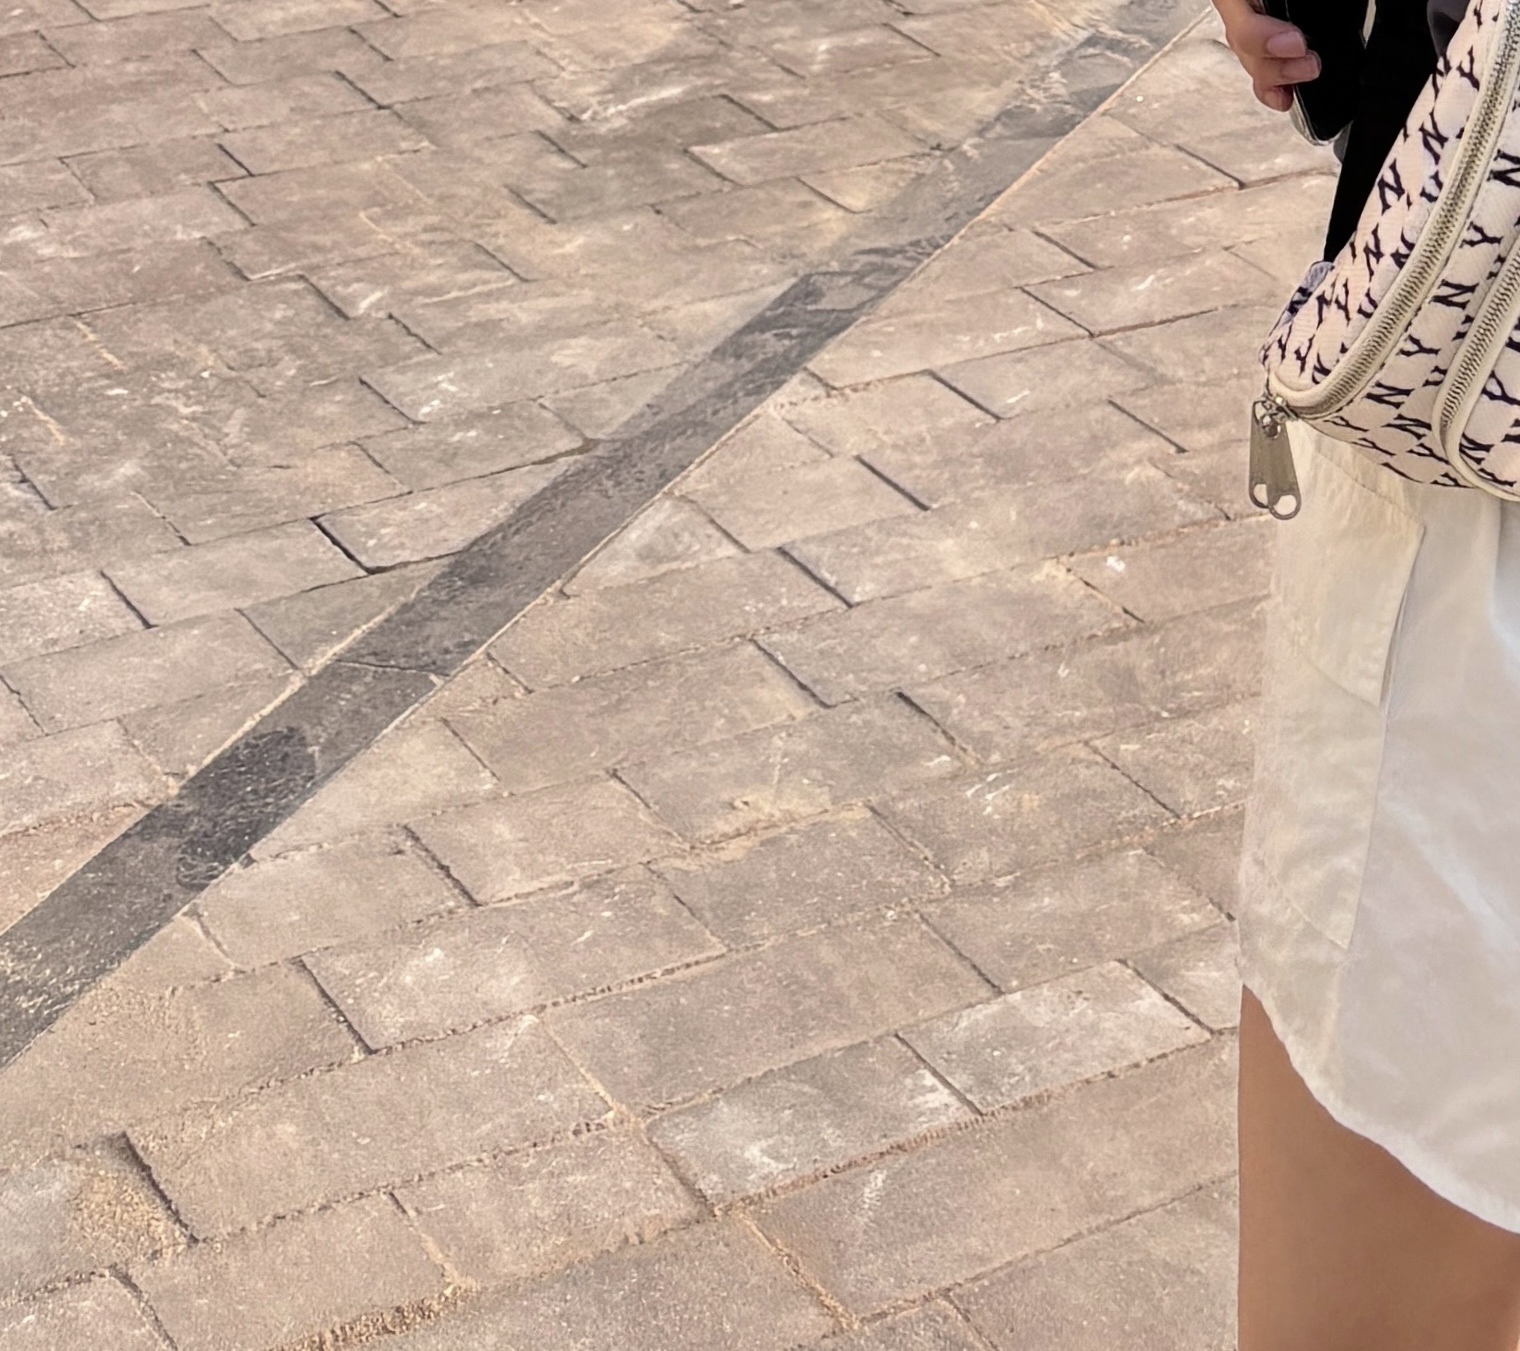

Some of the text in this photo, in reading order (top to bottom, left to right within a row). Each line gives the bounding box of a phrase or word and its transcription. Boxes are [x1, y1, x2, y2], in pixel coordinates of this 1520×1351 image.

[1456, 46, 1481, 92] Y
[1418, 107, 1449, 166] N
[1376, 158, 1406, 216] N
[1459, 220, 1504, 249] Y
[1363, 223, 1385, 282] N
[1334, 278, 1352, 326] Y
[1428, 278, 1480, 311] N
[1395, 334, 1442, 358] Y
[1364, 380, 1415, 410] N
[1323, 415, 1369, 433] Y
[1381, 413, 1433, 441] N
[1352, 437, 1396, 456] Y
